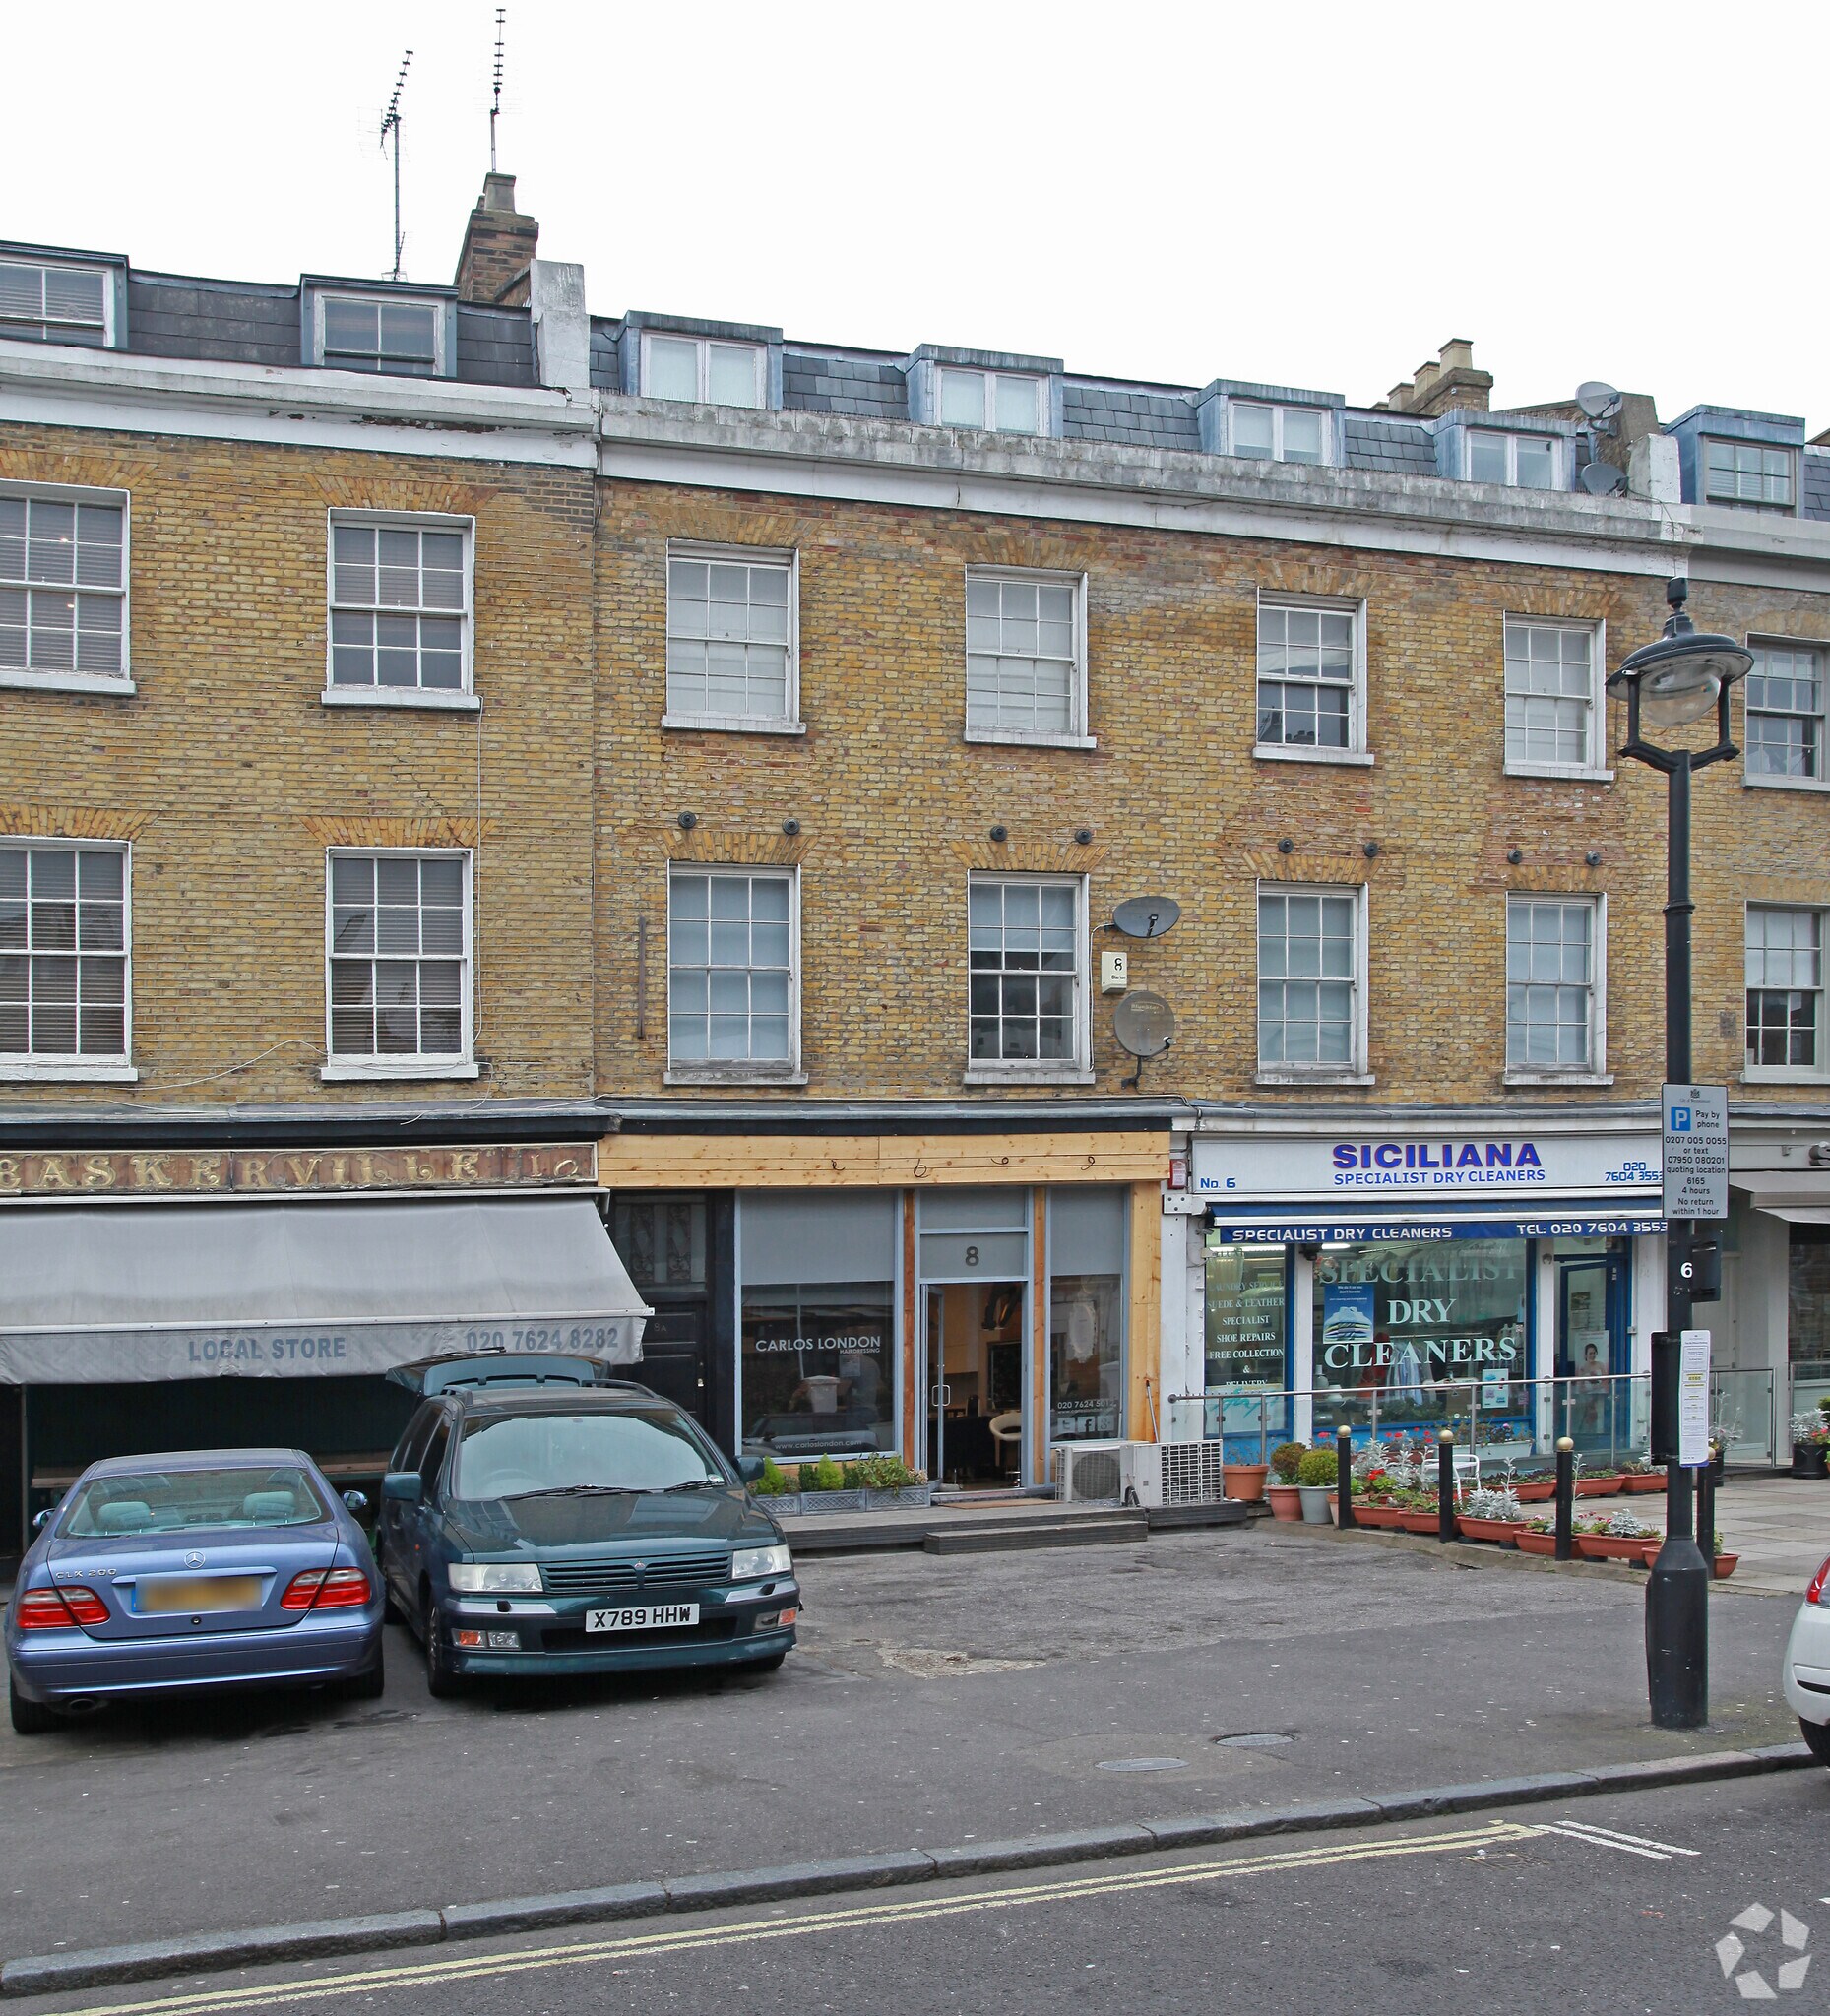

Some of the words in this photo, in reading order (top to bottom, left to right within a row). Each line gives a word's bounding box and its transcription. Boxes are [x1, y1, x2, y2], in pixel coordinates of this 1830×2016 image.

[1695, 1110, 1709, 1119] Pay
[1333, 1143, 1542, 1168] SICILIANA
[1623, 1162, 1646, 1171] 020
[1334, 1172, 1427, 1185] SPECIALIST
[1433, 1171, 1465, 1183] DRY
[1468, 1169, 1546, 1182] CLEANERS
[1605, 1171, 1634, 1181] 7604
[1200, 1177, 1221, 1188] No.
[1226, 1177, 1236, 1188] 6
[1517, 1225, 1546, 1234] TEL:
[1550, 1223, 1582, 1234] 020
[1587, 1222, 1628, 1233] 7604
[1232, 1229, 1327, 1241] SPECIALIST
[1334, 1228, 1367, 1240] DRY
[1372, 1228, 1452, 1239] CLEANERS
[966, 1246, 979, 1266] 8
[1319, 1256, 1517, 1284] SPECIALIST
[1681, 1262, 1693, 1278] 6
[1208, 1299, 1233, 1308] SUEDE
[1236, 1299, 1242, 1308] &
[1245, 1298, 1285, 1307] LEATHER
[1387, 1299, 1457, 1325] DRY
[1223, 1315, 1270, 1325] SPECIALIST
[467, 1331, 504, 1351] 020
[512, 1330, 562, 1351] 7624
[570, 1328, 618, 1349] 8282
[1217, 1333, 1237, 1343] SHOE
[1240, 1332, 1276, 1342] REPAIRS
[189, 1339, 262, 1361] LOCAL
[272, 1337, 347, 1359] STORE
[756, 1339, 813, 1352] CARLOS
[818, 1336, 881, 1350] LONDON
[1210, 1351, 1231, 1359] FREE
[1233, 1349, 1284, 1358] COLLECTION
[1324, 1337, 1517, 1368] CLEANERS
[1243, 1365, 1250, 1374] &
[775, 1439, 862, 1449] www.carloslondon.com
[88, 1568, 117, 1577] 200
[595, 1609, 646, 1628] X789
[653, 1606, 690, 1624] HHW
